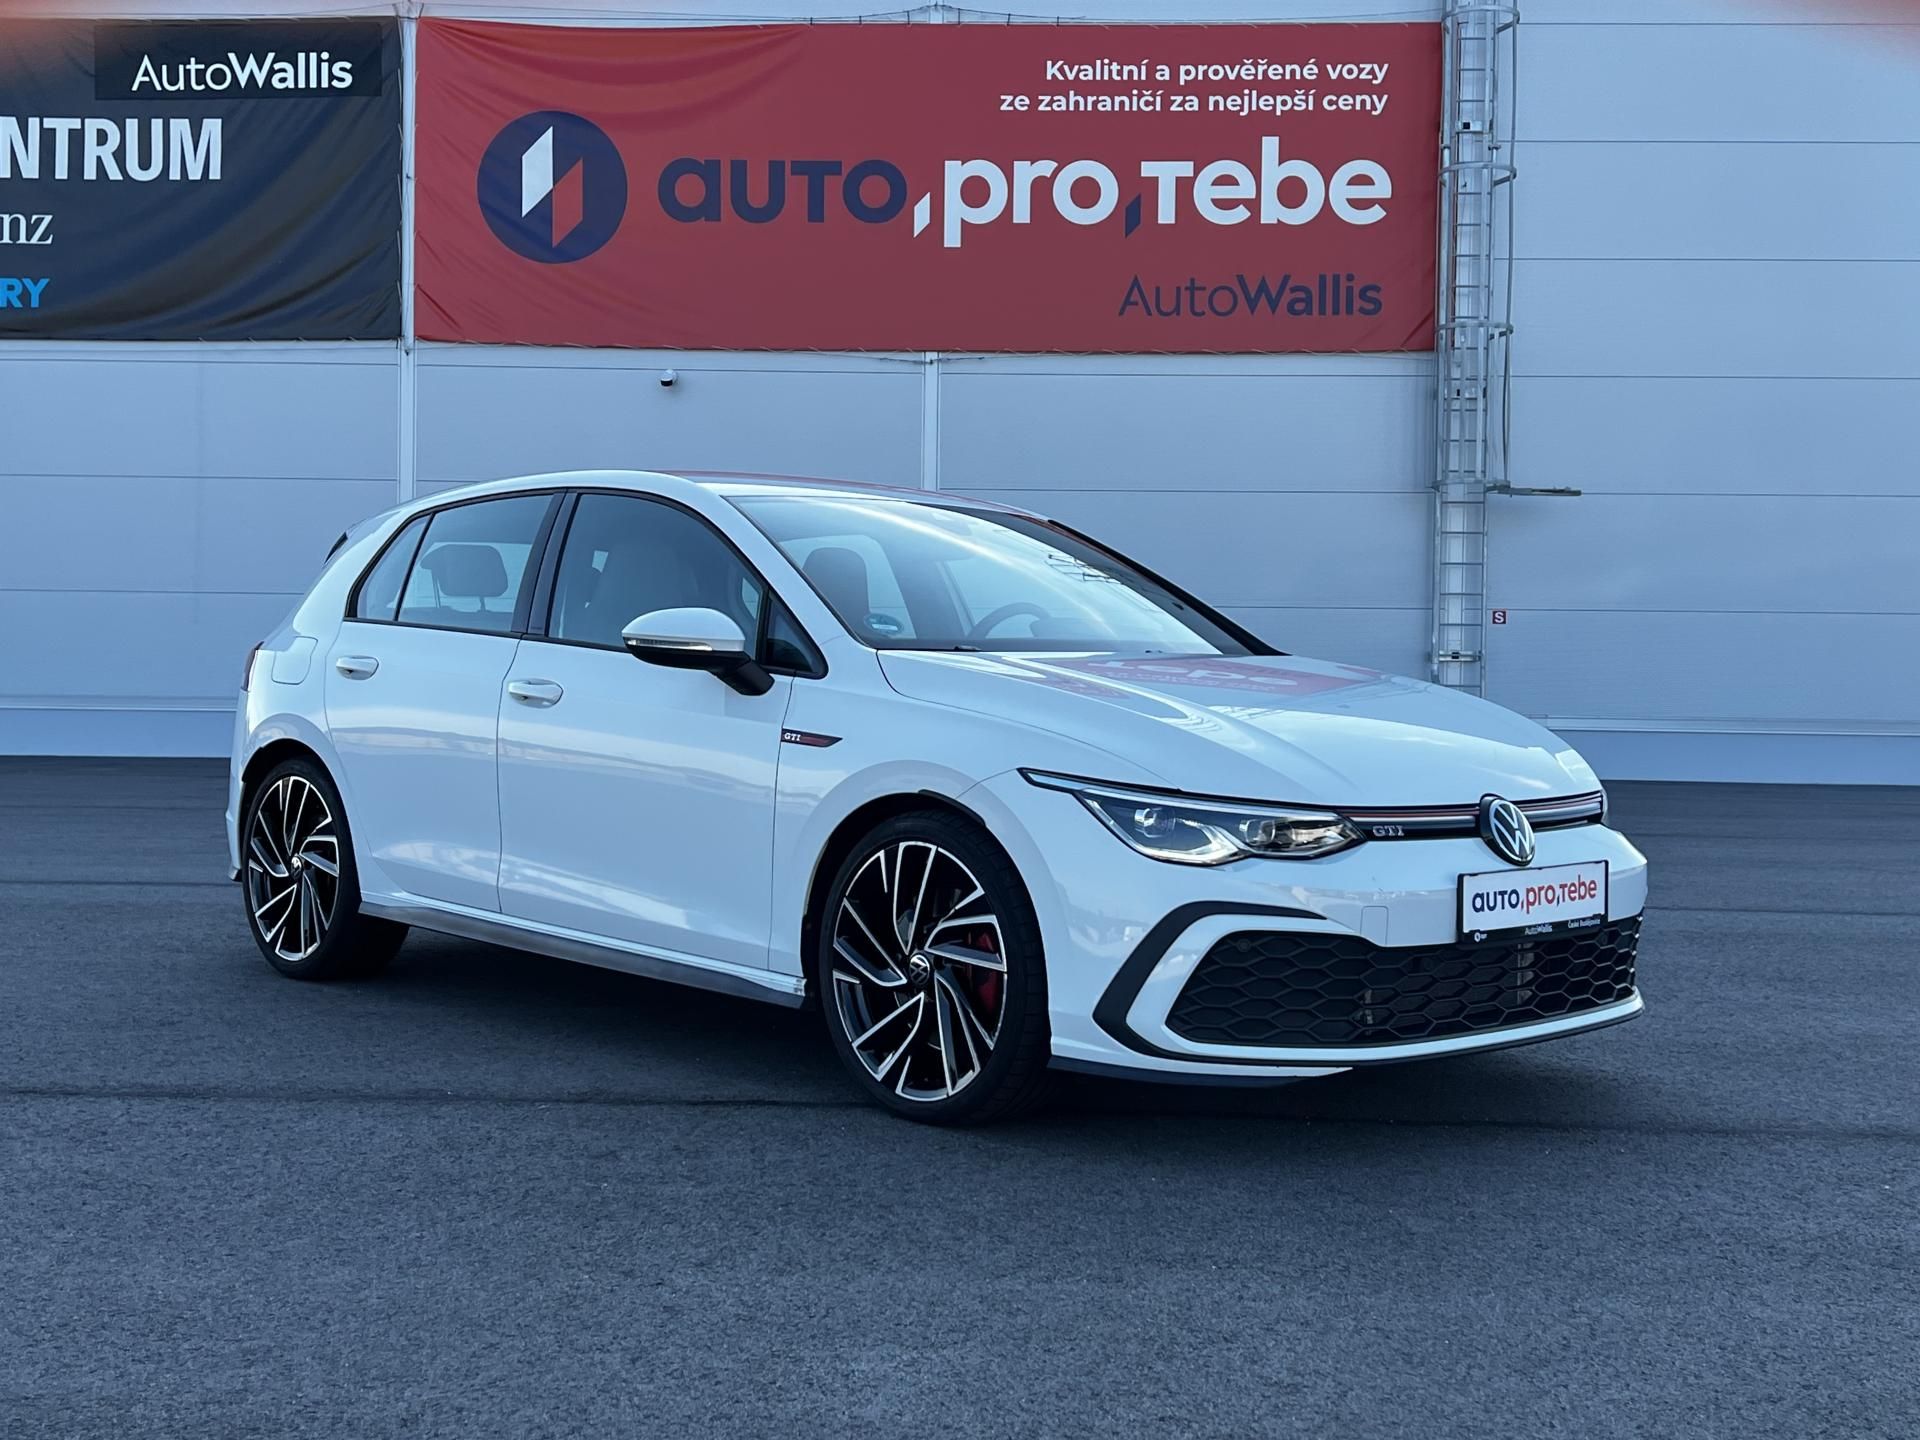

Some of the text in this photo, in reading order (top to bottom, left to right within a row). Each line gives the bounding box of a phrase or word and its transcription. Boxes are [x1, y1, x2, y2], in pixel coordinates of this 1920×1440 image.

[131, 51, 353, 91] AutoWallis
[1046, 57, 1389, 85] Kvalitní a prověřené vozy
[1000, 89, 1389, 116] ze zahraničí za nejlepší ceny
[0, 213, 53, 244] nz
[0, 277, 50, 308] RY
[1118, 273, 1383, 318] AutoWallis
[1494, 611, 1504, 623] S
[784, 732, 801, 741] GTI
[1372, 825, 1405, 837] GTI
